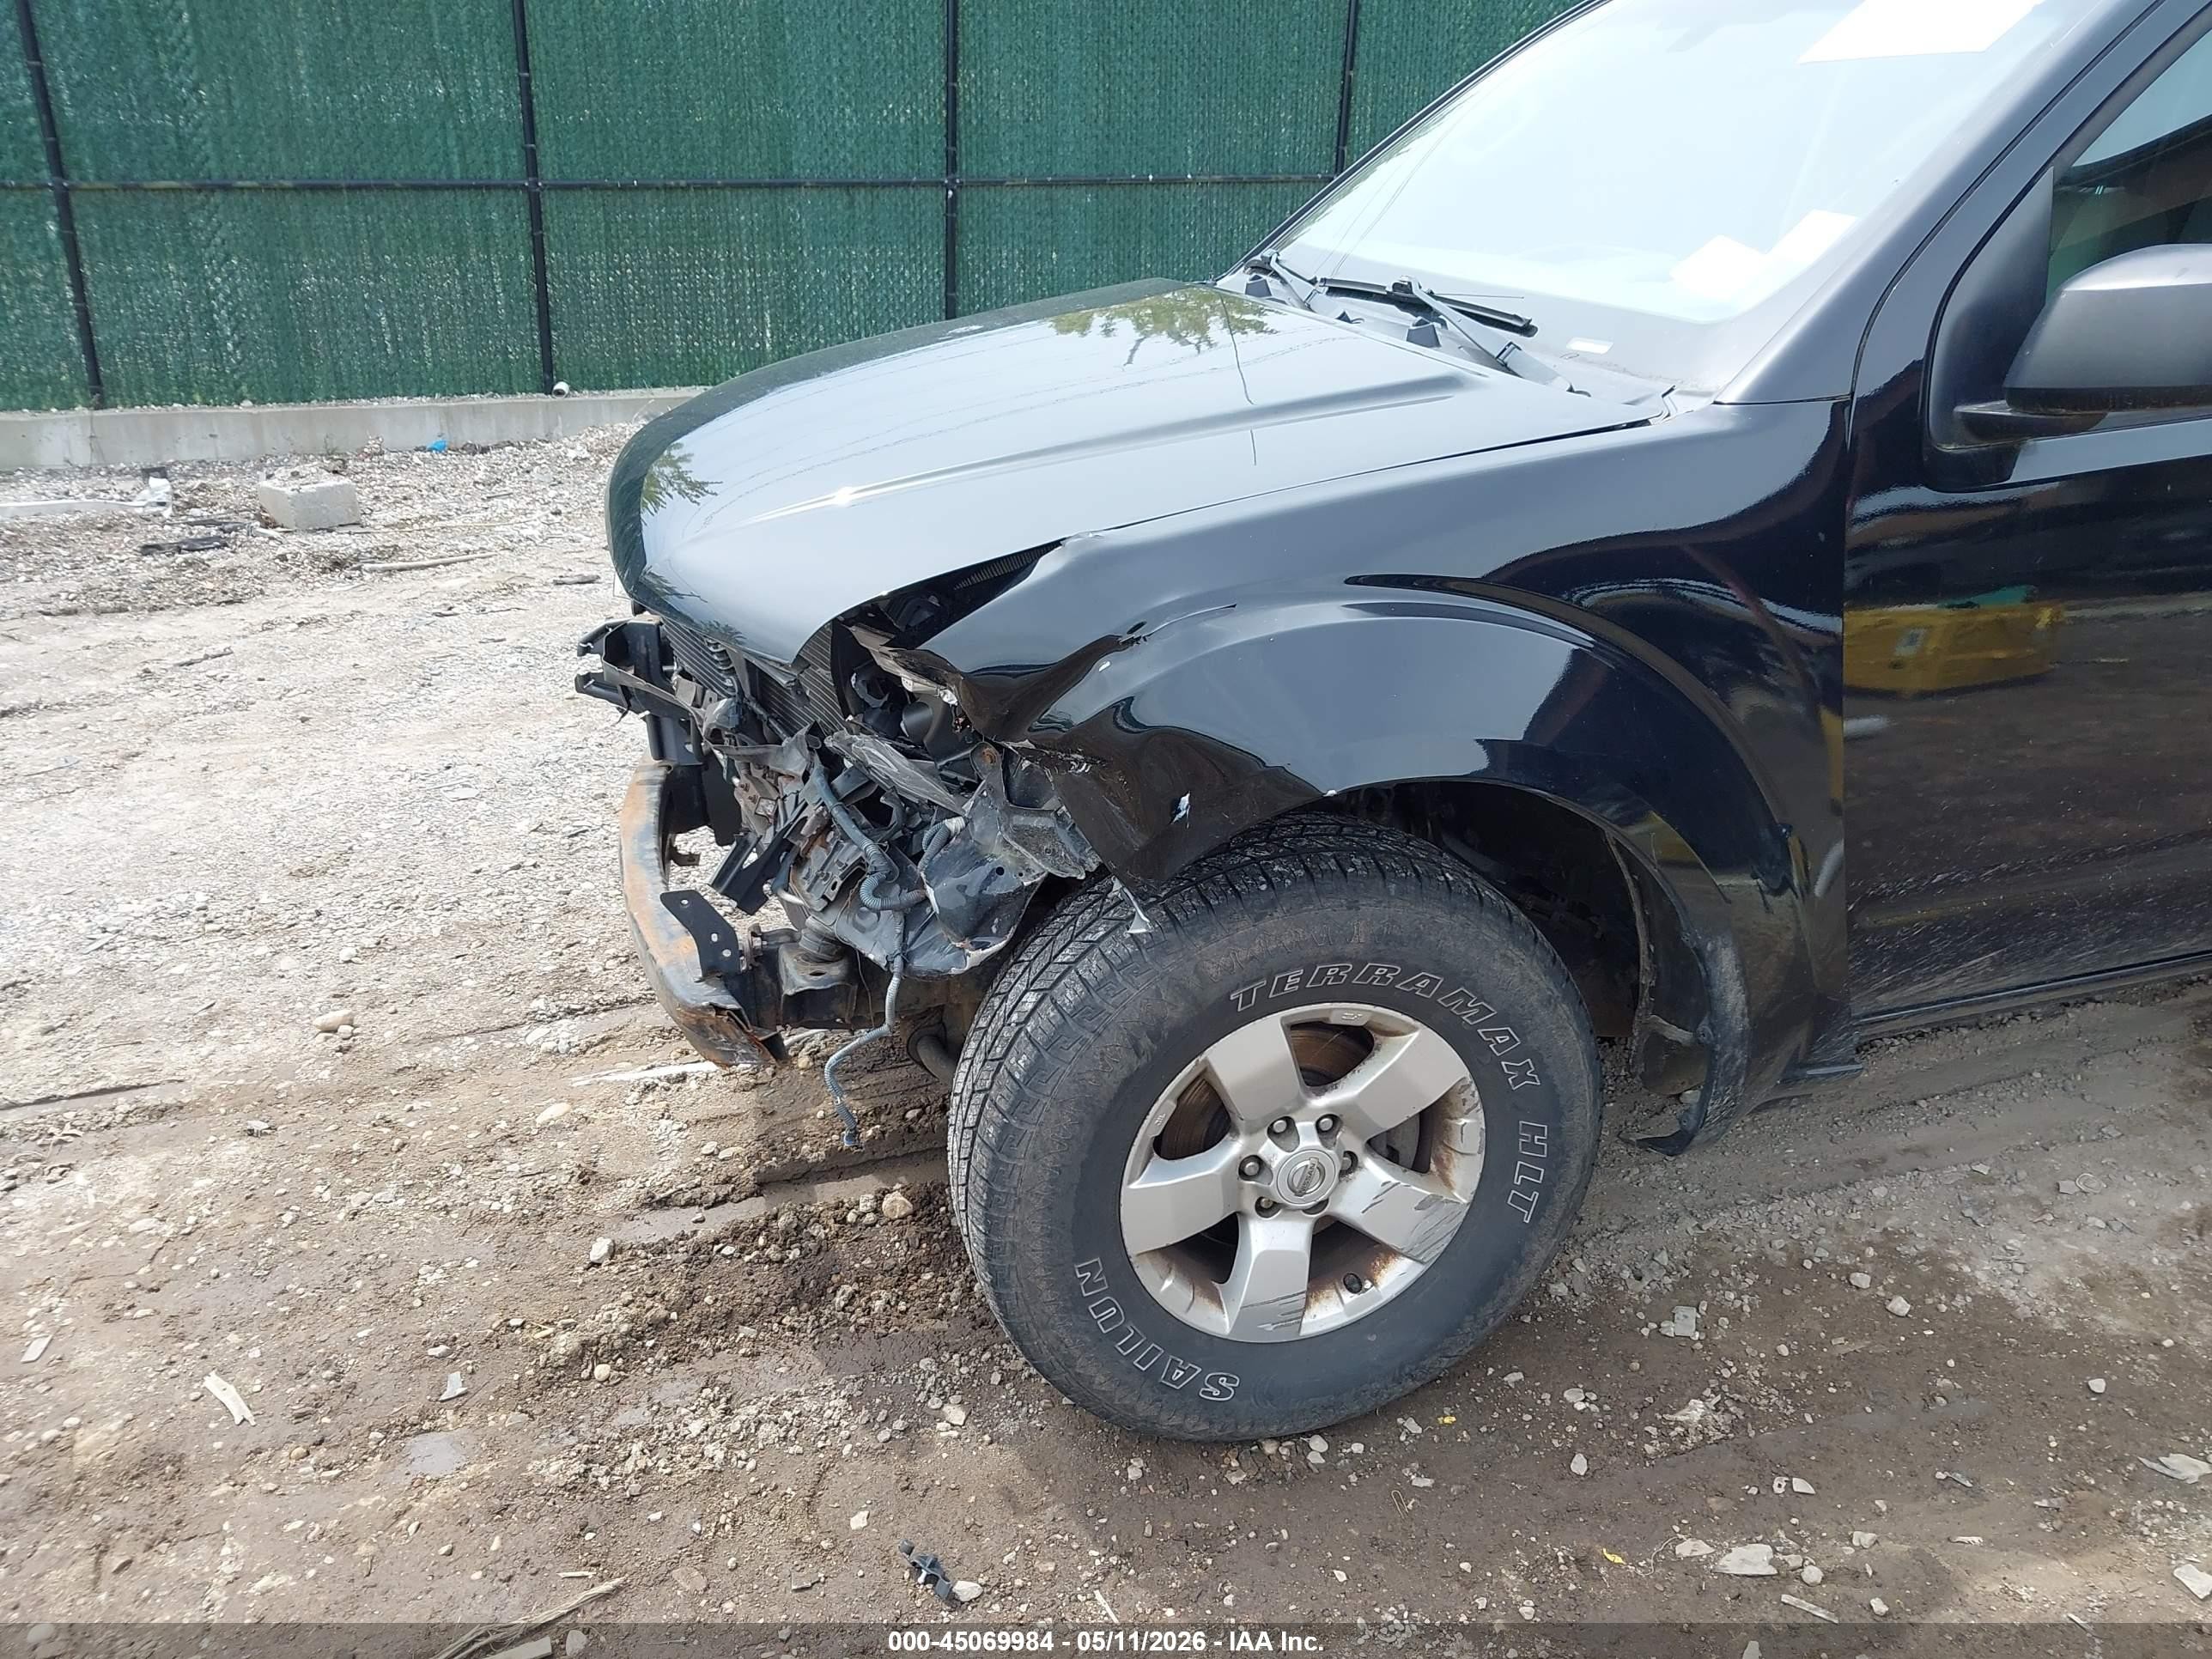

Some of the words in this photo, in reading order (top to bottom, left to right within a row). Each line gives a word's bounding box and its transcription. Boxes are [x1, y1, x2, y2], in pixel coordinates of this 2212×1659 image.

[1230, 962, 1540, 1091] TERRAMAX
[1507, 1120, 1548, 1224] HLT
[1299, 1162, 1317, 1194] NISSAN
[1074, 1257, 1240, 1401] SAILUN
